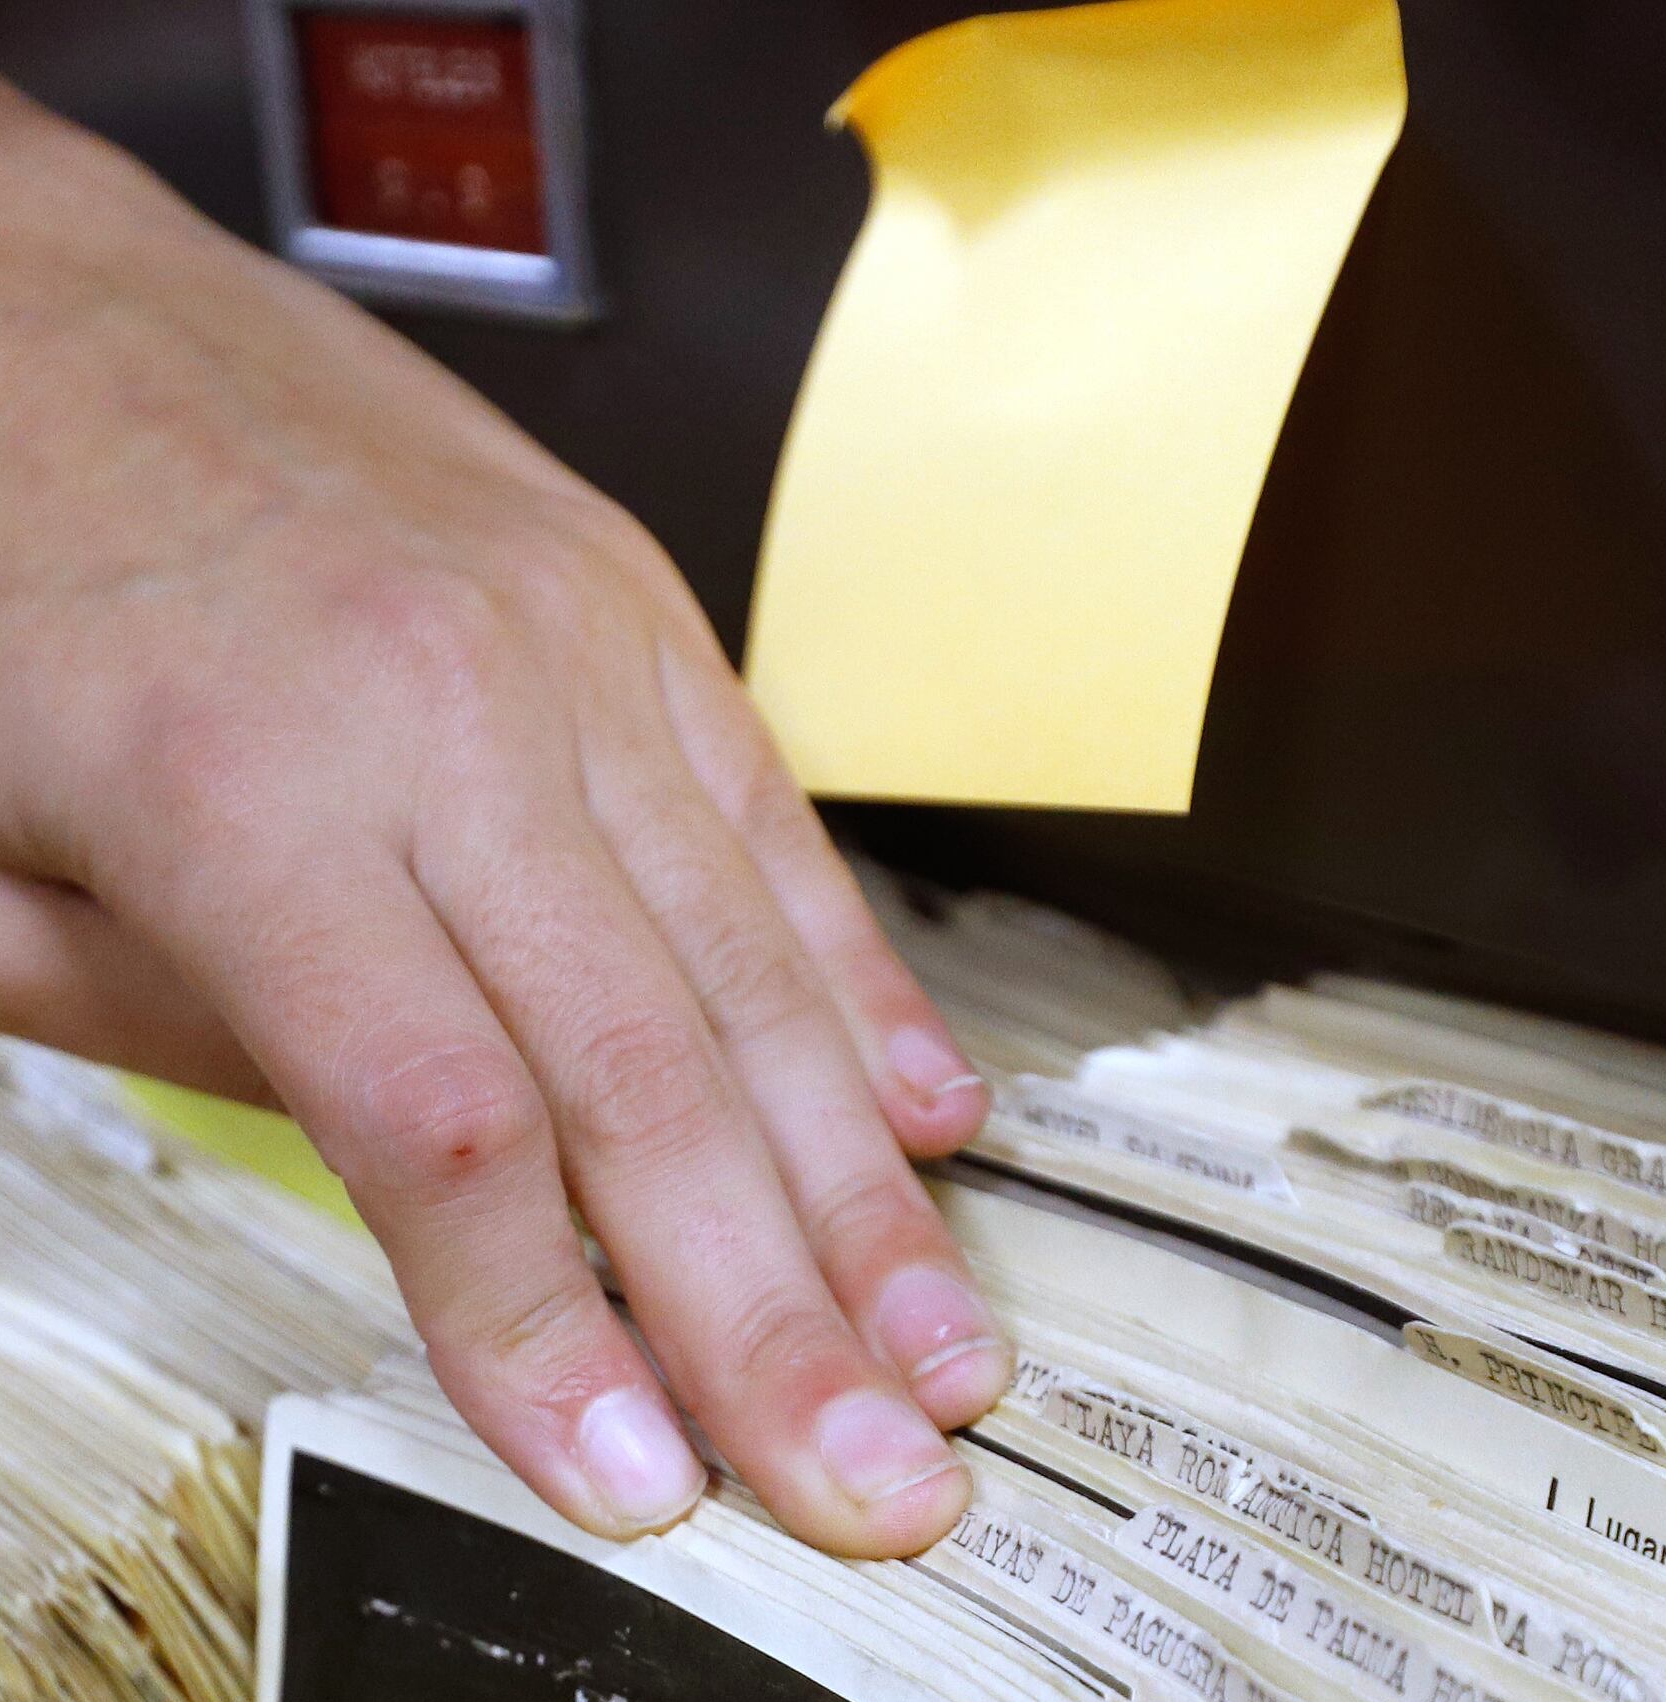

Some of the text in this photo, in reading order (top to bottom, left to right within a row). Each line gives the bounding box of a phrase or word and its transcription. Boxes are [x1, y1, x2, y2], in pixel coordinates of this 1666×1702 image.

[1478, 1350, 1664, 1454] PRINCIPE
[950, 1510, 1046, 1585] LAYAS
[1049, 1563, 1097, 1617] DE
[1142, 1510, 1244, 1592] PLAYA
[1248, 1567, 1298, 1623] DE
[1305, 1599, 1411, 1696] PALMA
[1364, 1537, 1477, 1629] HOTEL
